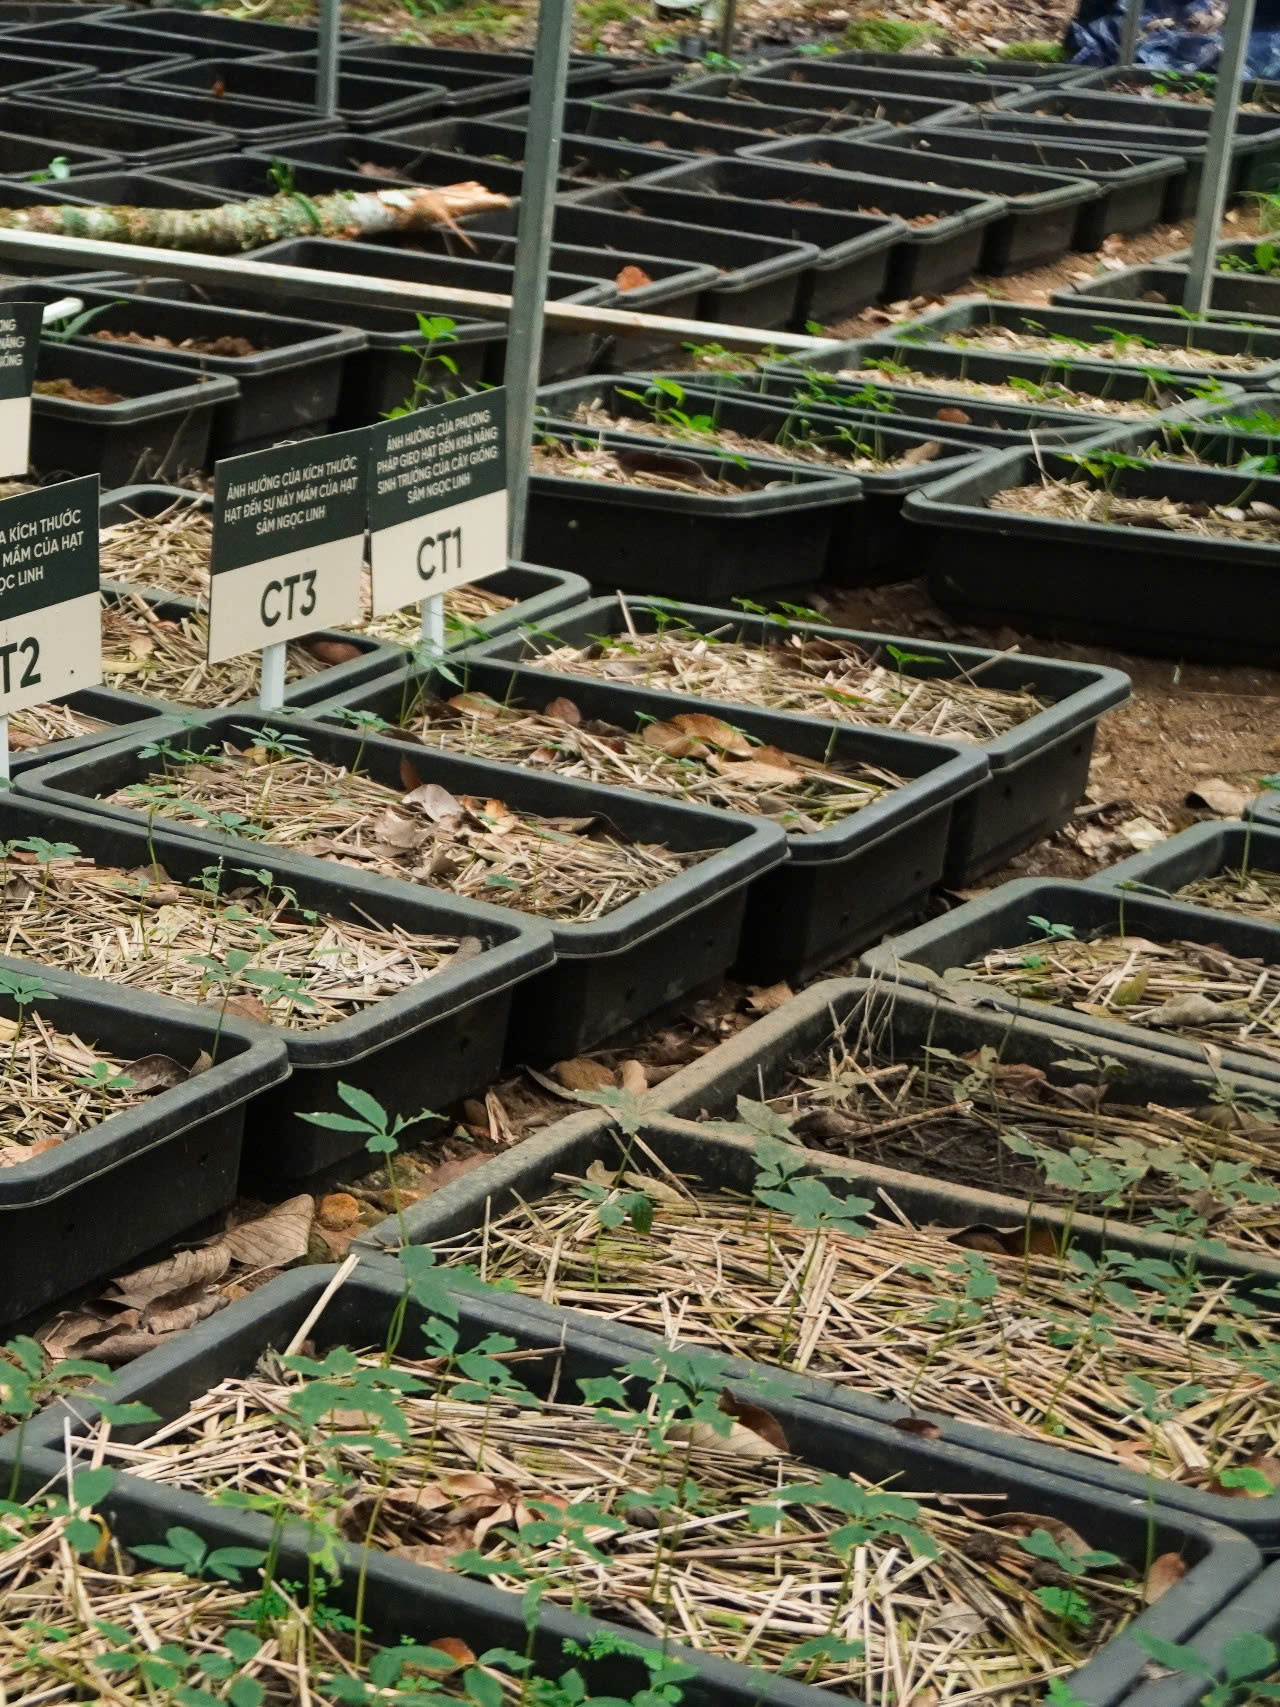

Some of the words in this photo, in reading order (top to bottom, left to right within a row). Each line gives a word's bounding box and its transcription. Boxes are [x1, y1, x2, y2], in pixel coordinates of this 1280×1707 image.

[227, 482, 245, 501] ẢNH
[282, 467, 301, 486] CỦA
[302, 463, 324, 481] KÍCH
[377, 478, 396, 495] SINH
[453, 472, 471, 489] LINH
[224, 506, 242, 525] HẠT
[244, 497, 261, 518] ĐẾN
[263, 495, 275, 515] SỰ
[319, 478, 338, 498] CỦA
[340, 476, 358, 495] HẠT
[9, 521, 37, 541] KÍCH
[40, 508, 81, 533] THƯỚC
[256, 517, 275, 536] SÂM
[277, 511, 304, 530] NGỌC
[306, 505, 325, 523] LINH
[34, 536, 59, 557] CỦA
[61, 531, 84, 552] HẠT
[416, 526, 461, 580] CT1
[18, 565, 44, 586] LINH
[261, 569, 317, 627] CT3
